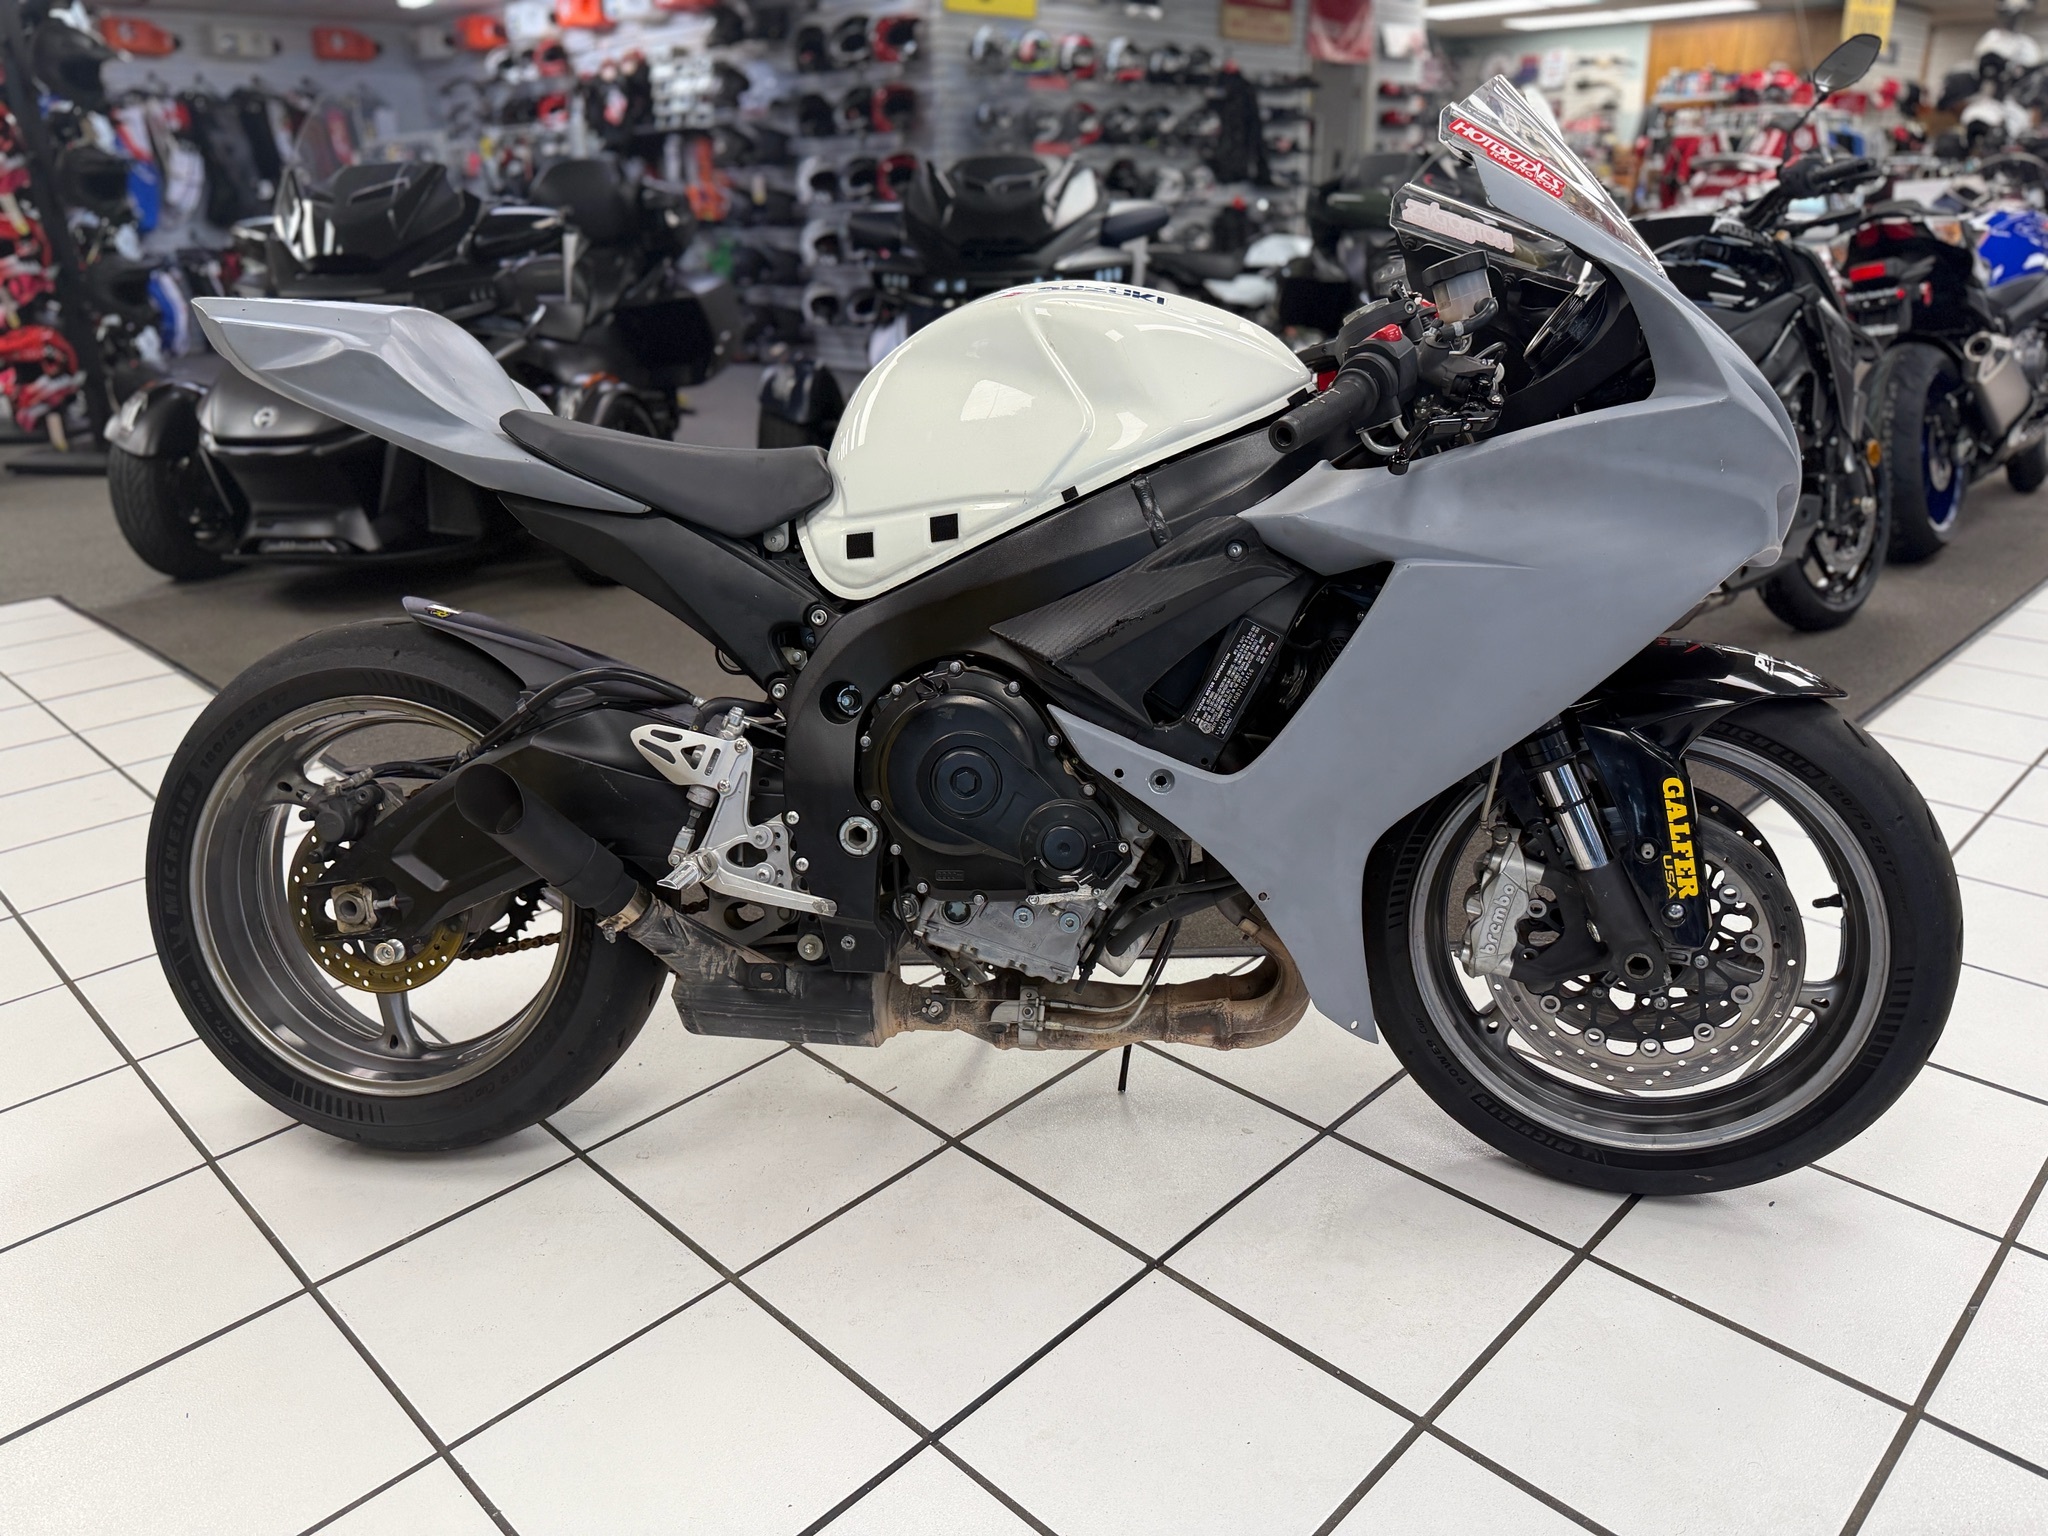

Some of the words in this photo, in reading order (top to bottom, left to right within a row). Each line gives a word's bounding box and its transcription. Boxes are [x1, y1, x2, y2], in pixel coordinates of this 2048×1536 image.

[1453, 121, 1565, 190] HOTBODIES
[1489, 151, 1562, 196] RACING.COM
[163, 783, 196, 916] MICHELIN
[1662, 777, 1699, 899] GALFER
[1828, 782, 1873, 832] 120/70
[1868, 832, 1888, 856] ZR
[1882, 858, 1898, 877] 17
[1662, 854, 1677, 899] USA
[1480, 883, 1516, 955] brembo
[1425, 1039, 1467, 1086] POWER
[1475, 1095, 1577, 1154] MICHELIN
